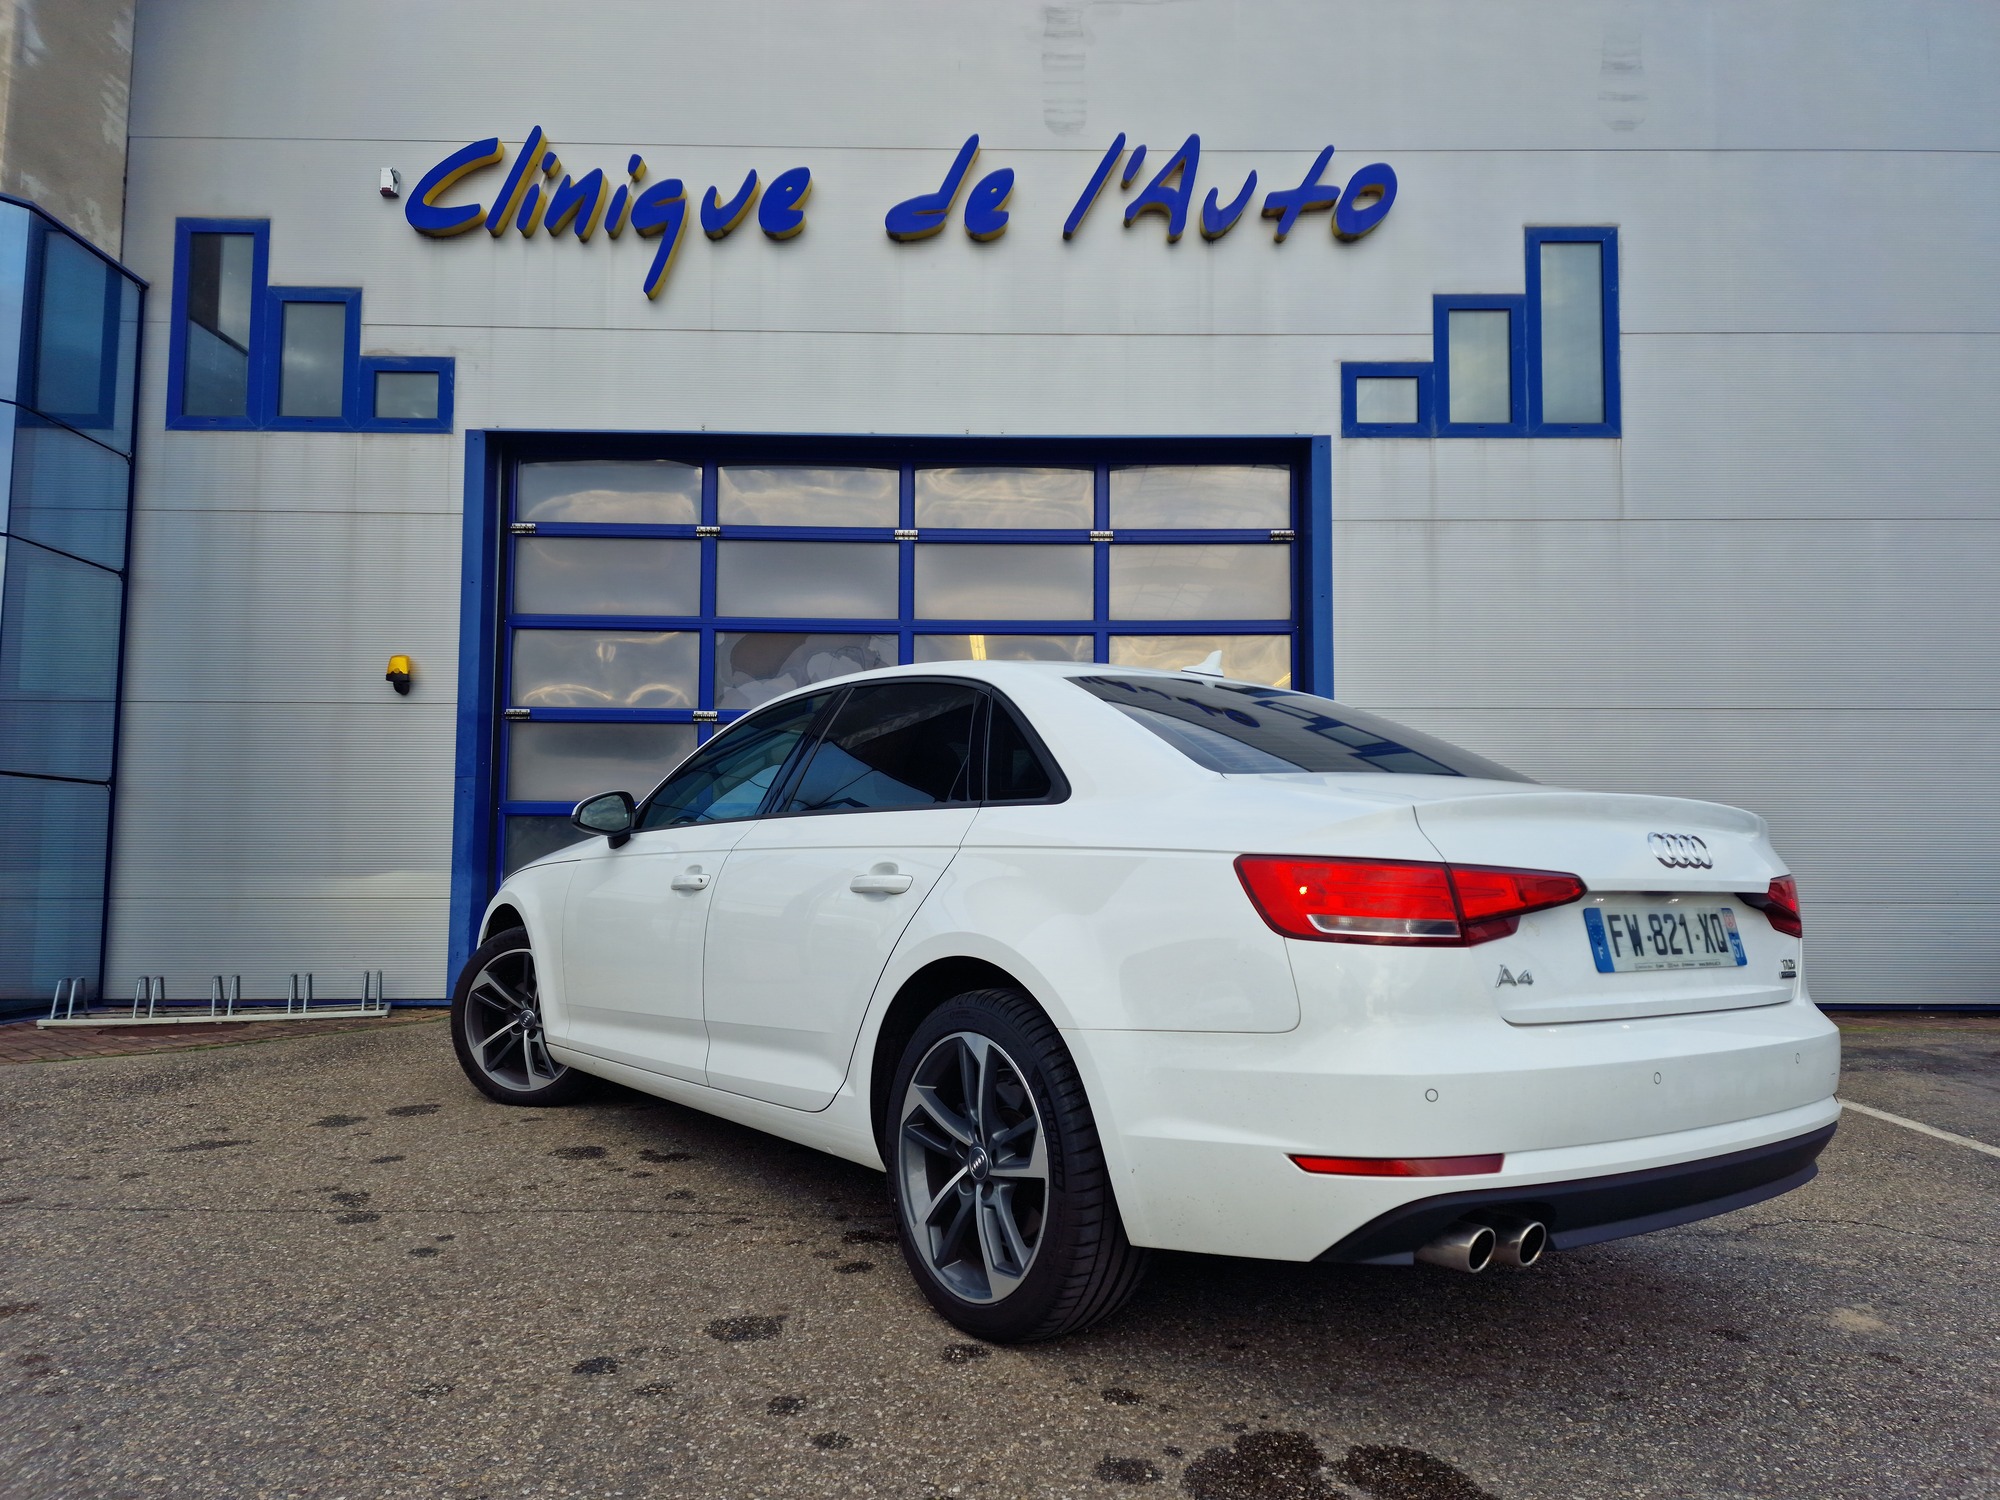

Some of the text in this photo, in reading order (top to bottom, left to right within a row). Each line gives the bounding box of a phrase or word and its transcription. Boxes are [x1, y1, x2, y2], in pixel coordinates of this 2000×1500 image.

[405, 125, 1398, 299] Clinique de l'Auto
[1495, 964, 1535, 988] A4
[1041, 1096, 1065, 1188] MICHELIN
